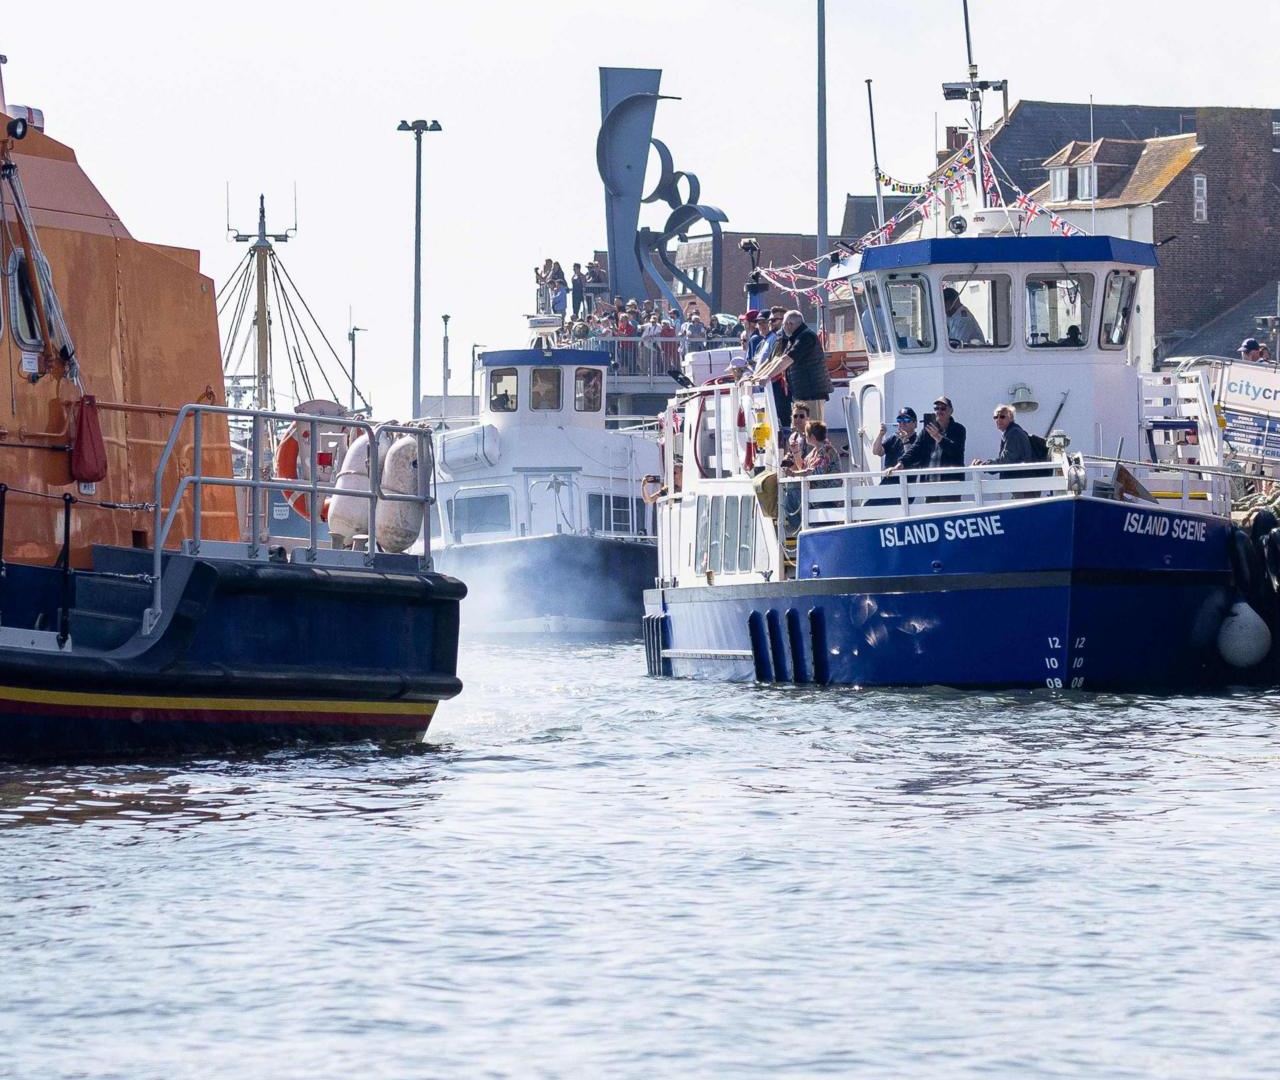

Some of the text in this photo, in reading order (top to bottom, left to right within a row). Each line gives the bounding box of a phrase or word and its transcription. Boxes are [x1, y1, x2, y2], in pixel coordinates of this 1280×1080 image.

[880, 515, 1005, 548] ISLAND SCENE
[1123, 512, 1207, 542] ISLAND SCENE
[1048, 637, 1061, 648] 12
[1075, 637, 1086, 648] 12
[1045, 657, 1059, 669] 10
[1073, 657, 1084, 669] 10
[1046, 677, 1062, 689] 08
[1071, 676, 1084, 688] 08
